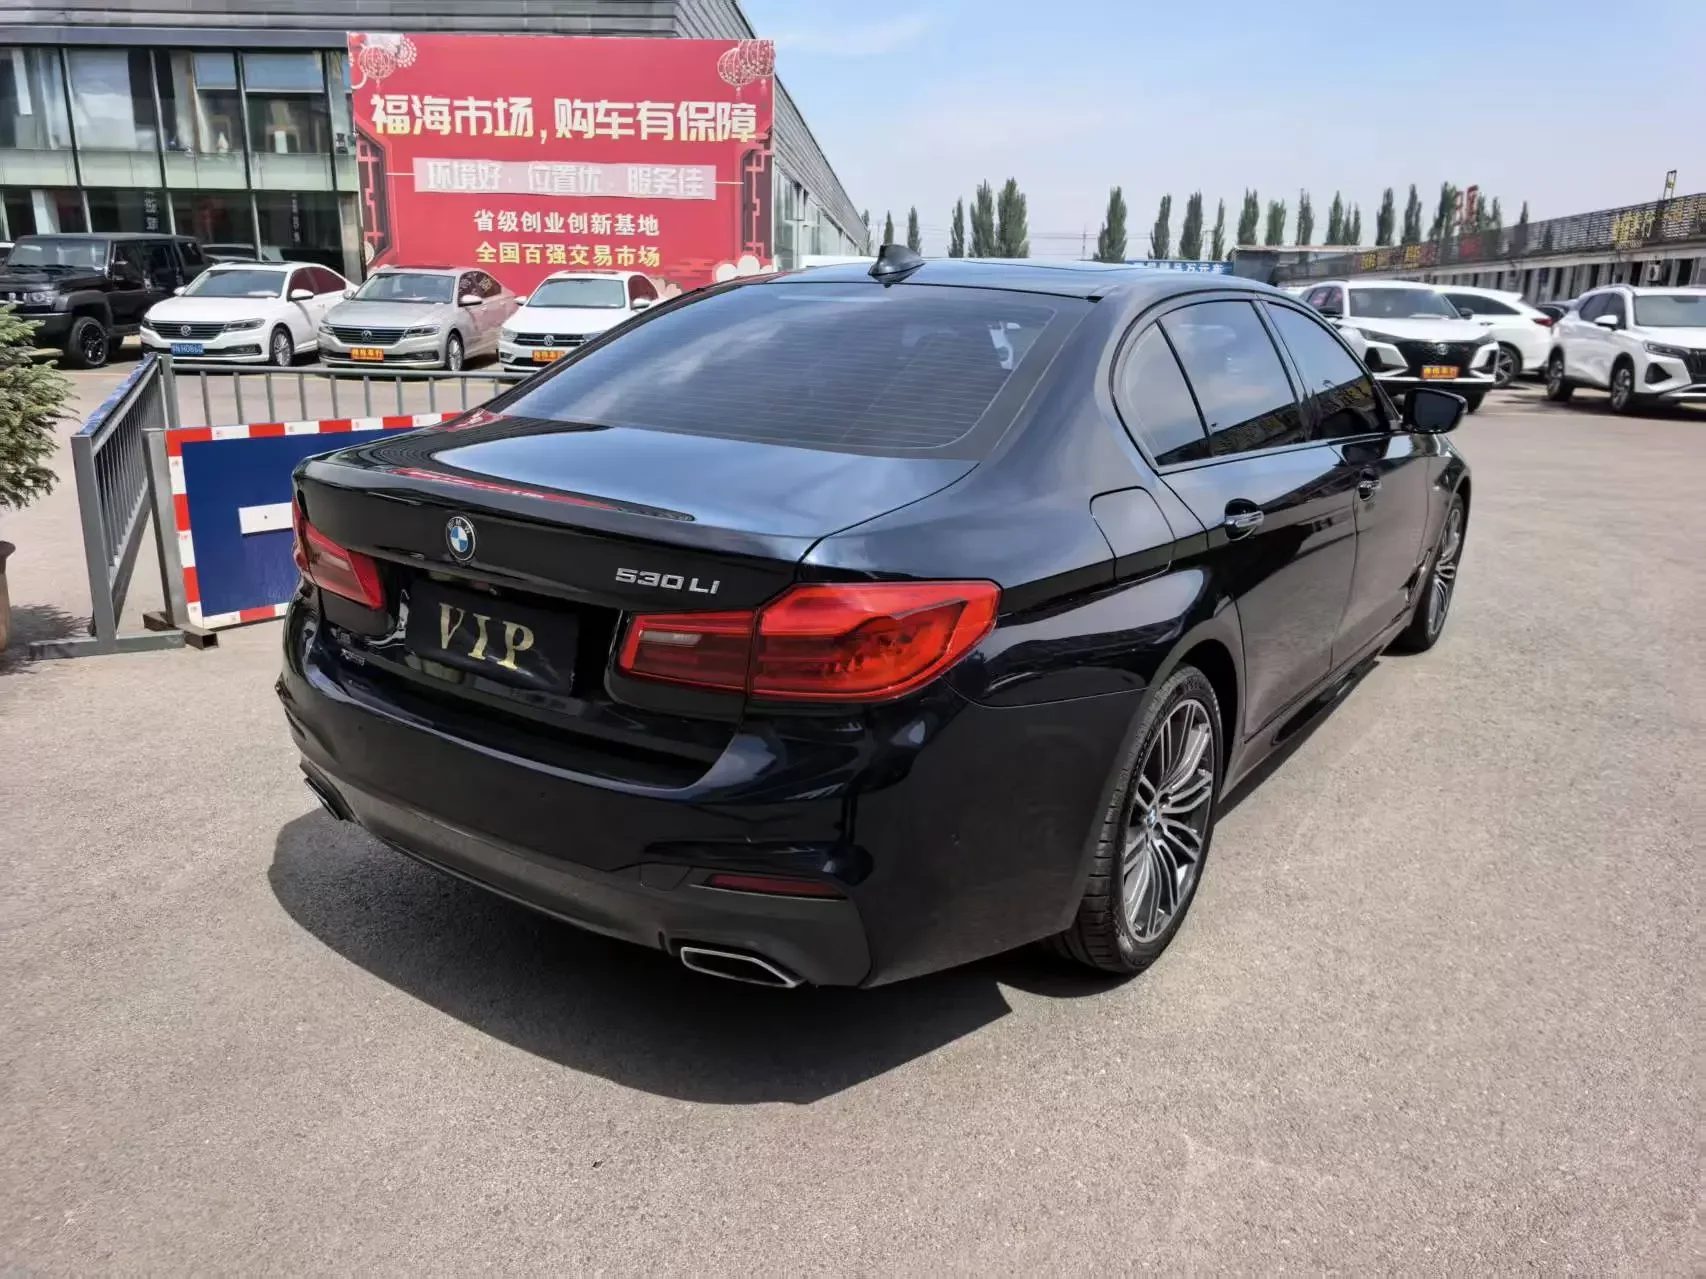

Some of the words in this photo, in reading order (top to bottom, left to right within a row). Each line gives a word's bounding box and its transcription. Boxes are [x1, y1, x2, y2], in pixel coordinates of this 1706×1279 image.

[370, 94, 757, 144] 福海市场,购车有保障
[427, 161, 502, 190] 环境好
[528, 163, 602, 194] 位置优
[627, 166, 704, 196] 服务佳
[474, 209, 660, 236] 省级创业创新基地
[476, 241, 660, 267] 全国百强交易市场
[439, 602, 534, 670] VIP
